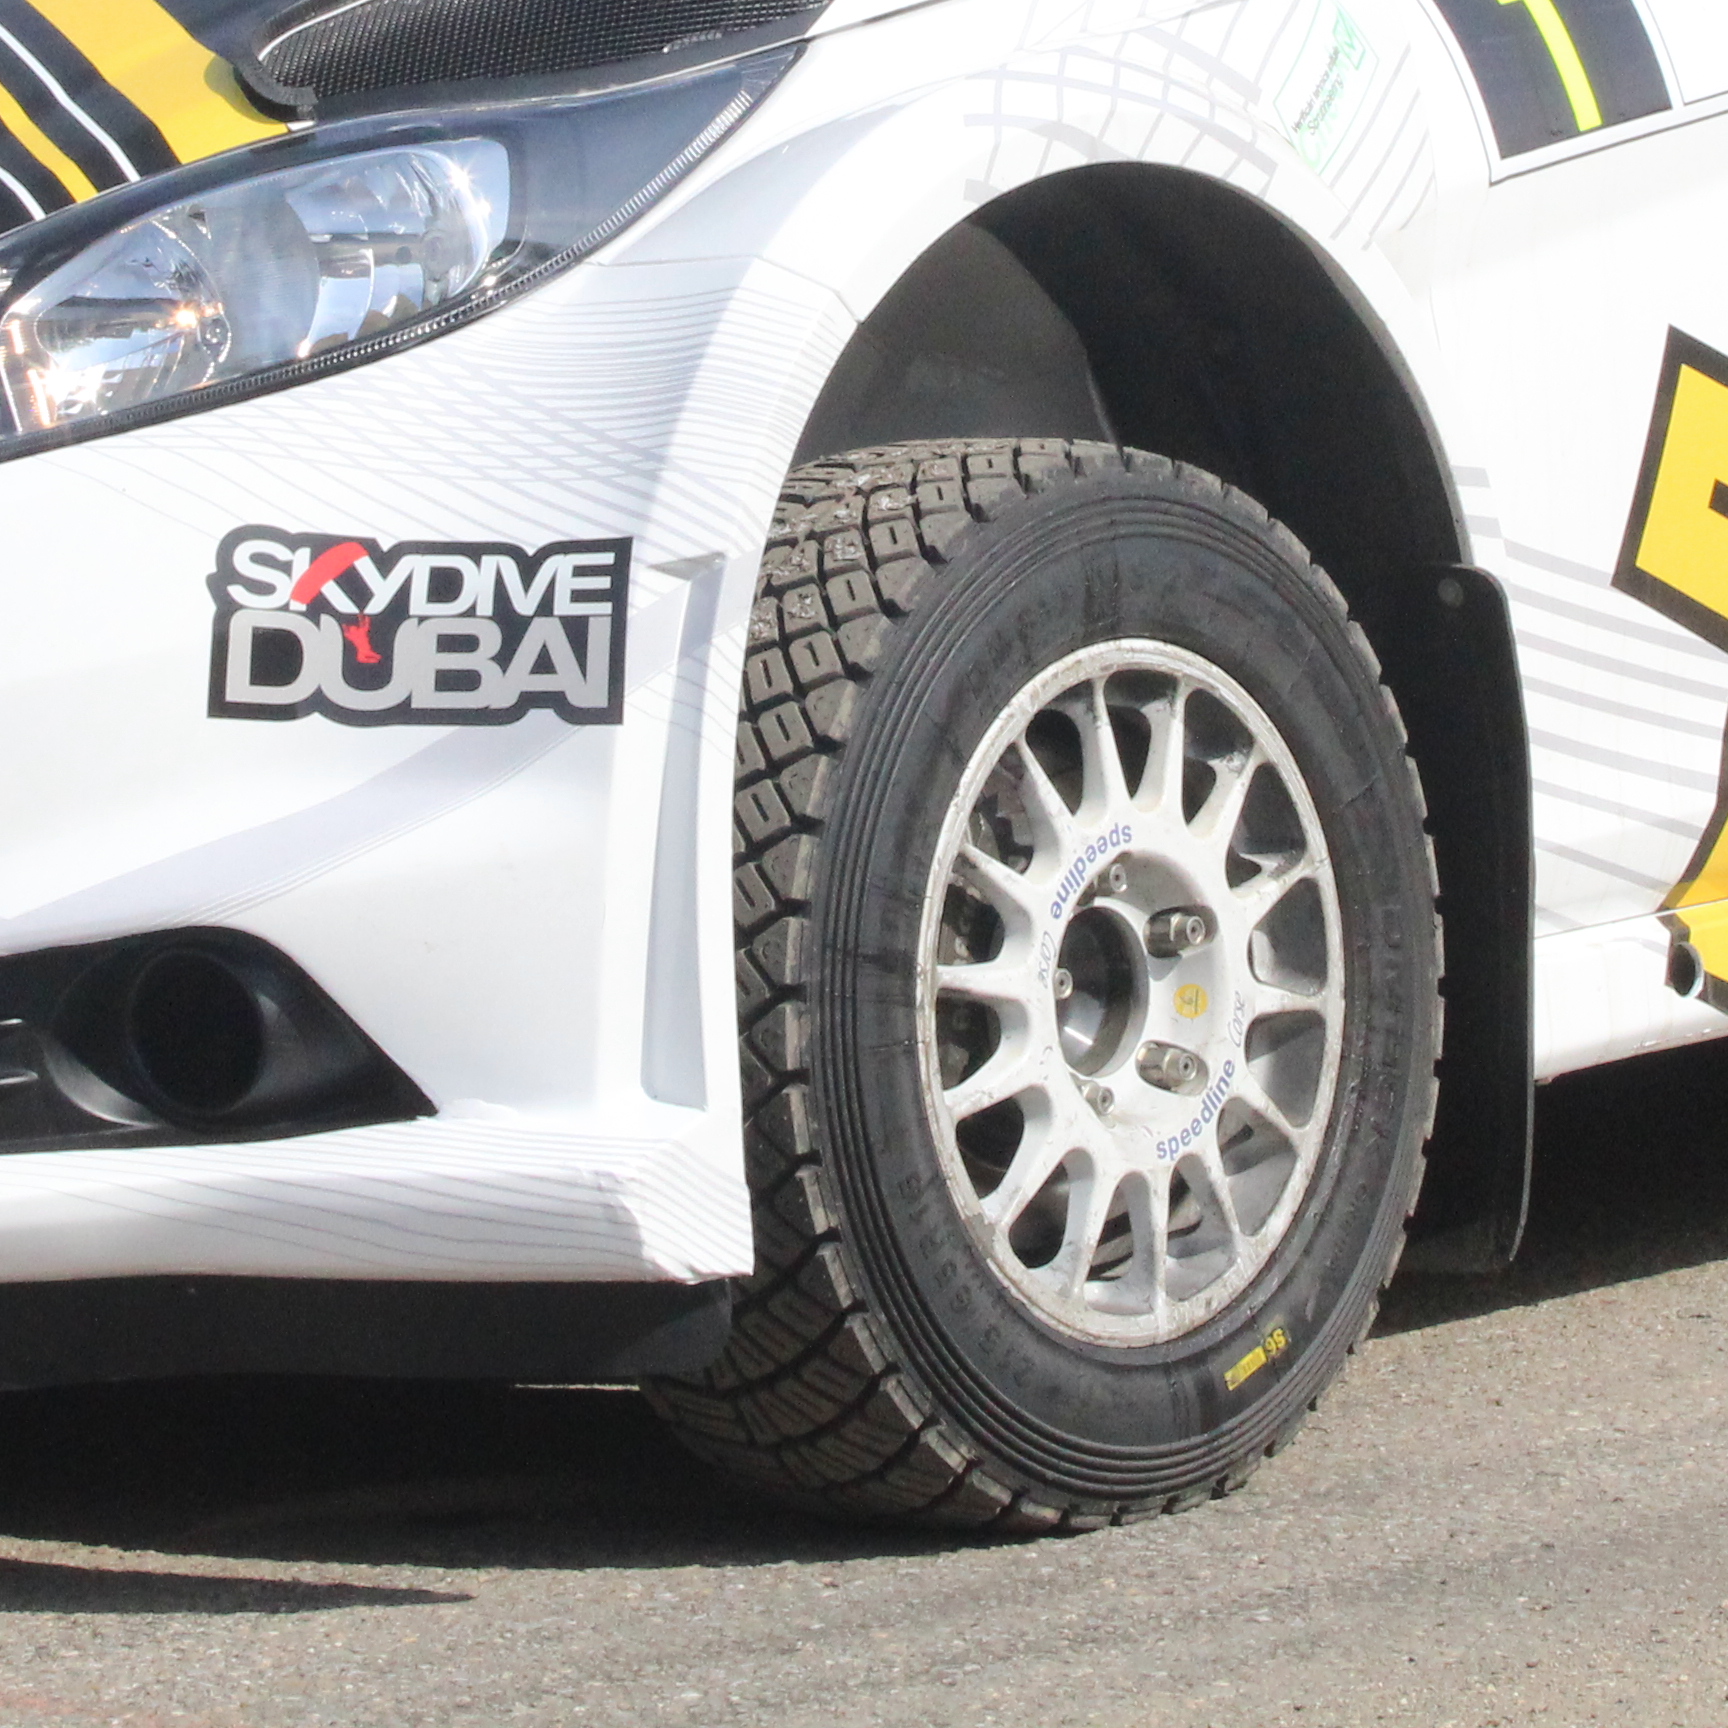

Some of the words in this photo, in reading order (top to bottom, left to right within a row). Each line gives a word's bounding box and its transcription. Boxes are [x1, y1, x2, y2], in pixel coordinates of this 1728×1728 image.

[227, 538, 616, 617] SKYDIVE
[225, 609, 613, 711] DUBAI
[1050, 823, 1133, 920] speedline
[1156, 1058, 1236, 1162] speedline
